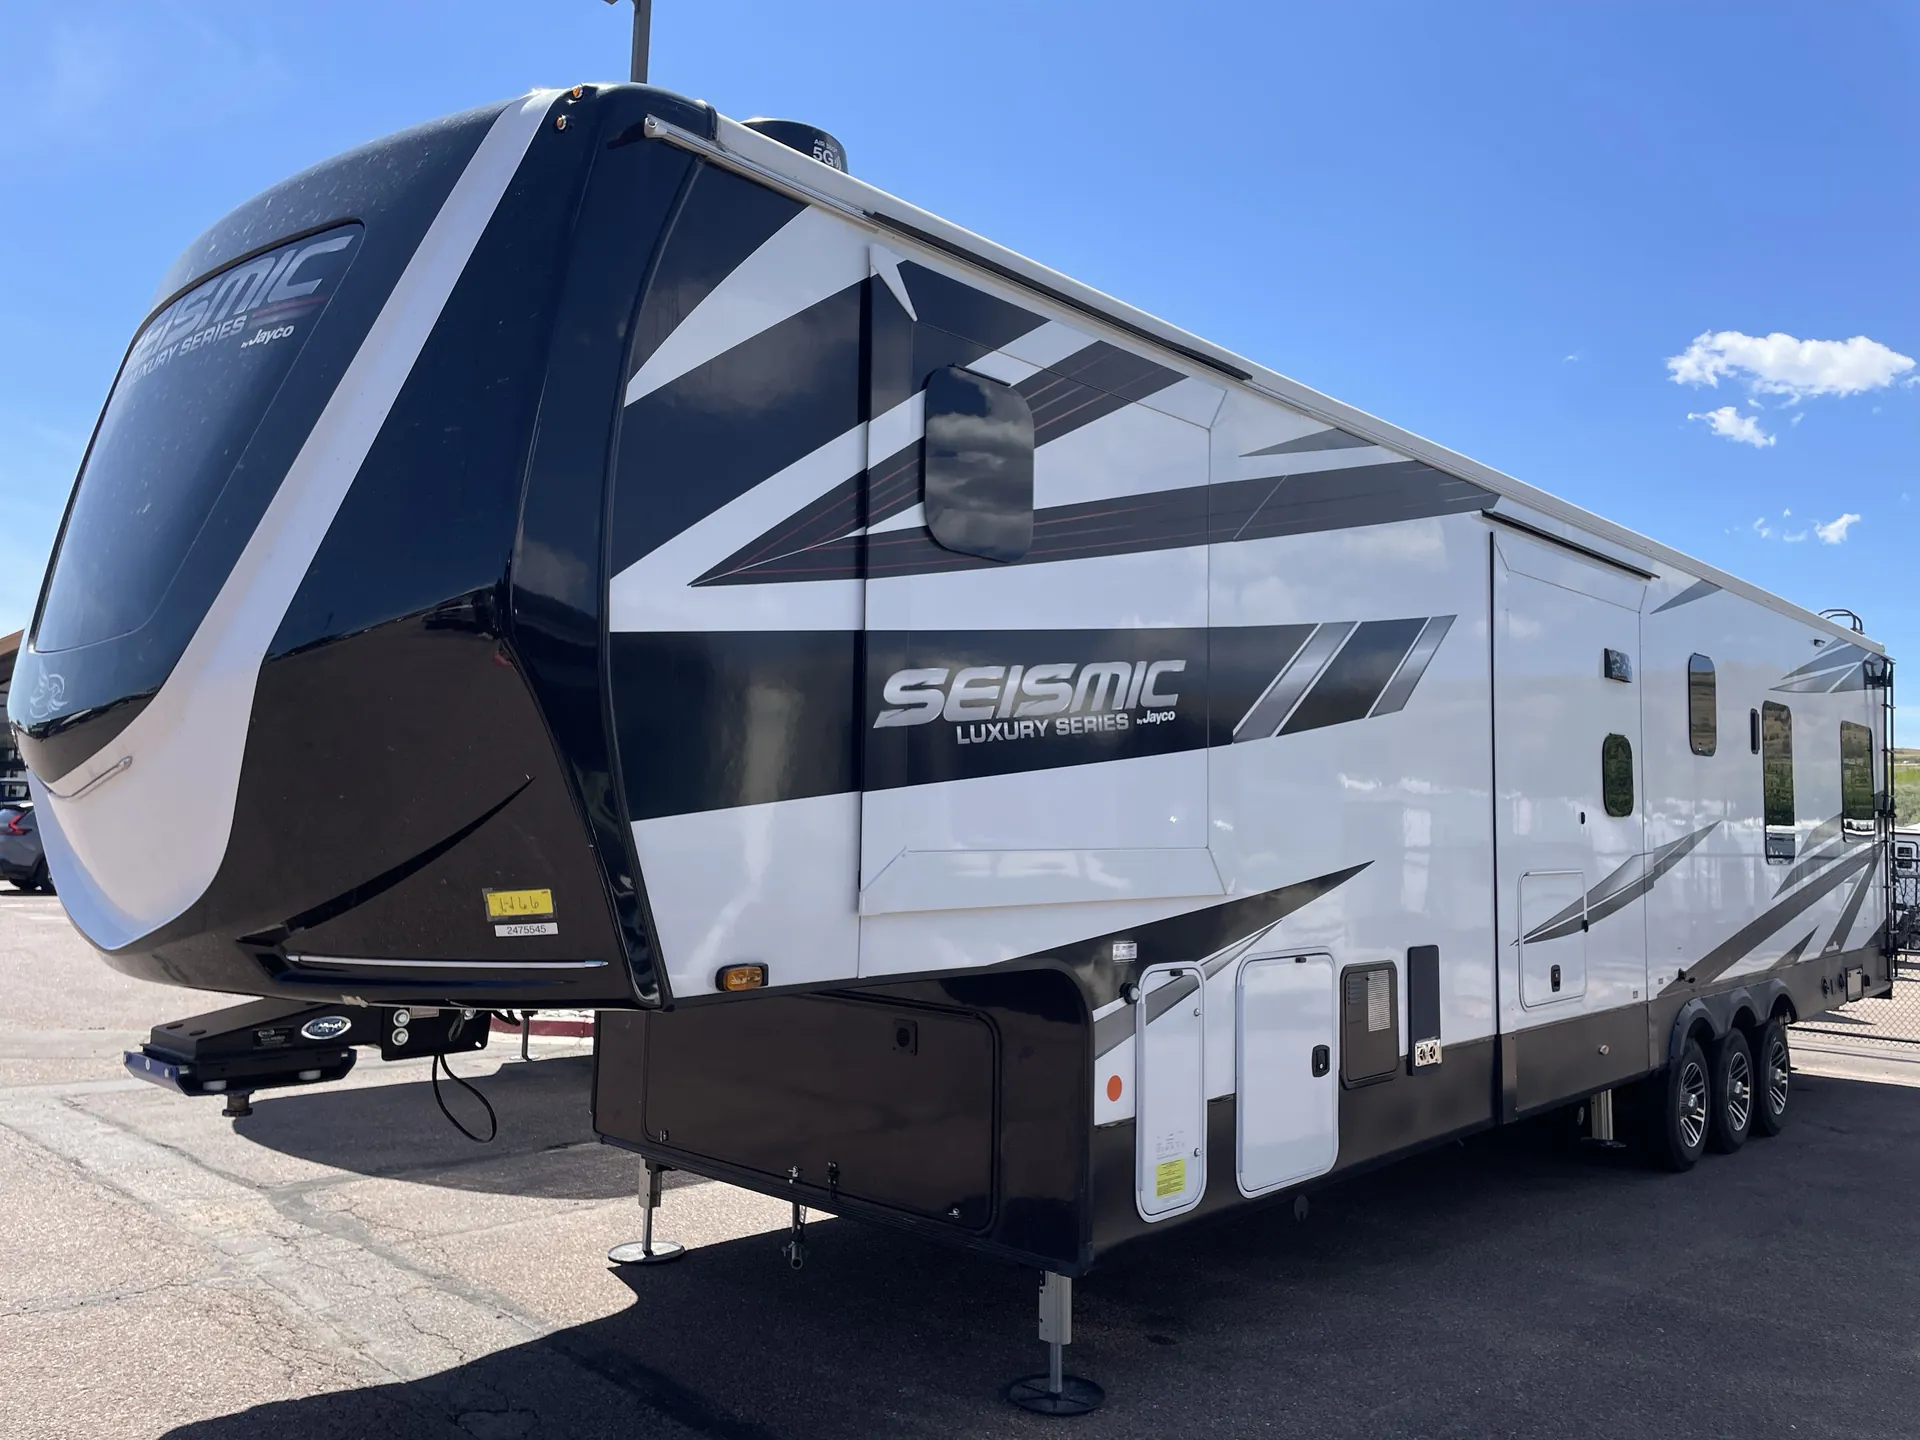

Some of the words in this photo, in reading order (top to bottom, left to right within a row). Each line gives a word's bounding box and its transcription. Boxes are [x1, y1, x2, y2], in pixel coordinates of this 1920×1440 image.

[814, 139, 825, 147] AIR
[813, 147, 834, 166] 5G
[178, 315, 247, 357] SERIES
[248, 325, 294, 345] Jayco
[873, 660, 1187, 729] SEISMIC
[1143, 710, 1175, 725] Jayco
[956, 719, 1050, 745] LUXURY
[1055, 712, 1129, 736] SERIES
[506, 924, 547, 935] 2475545
